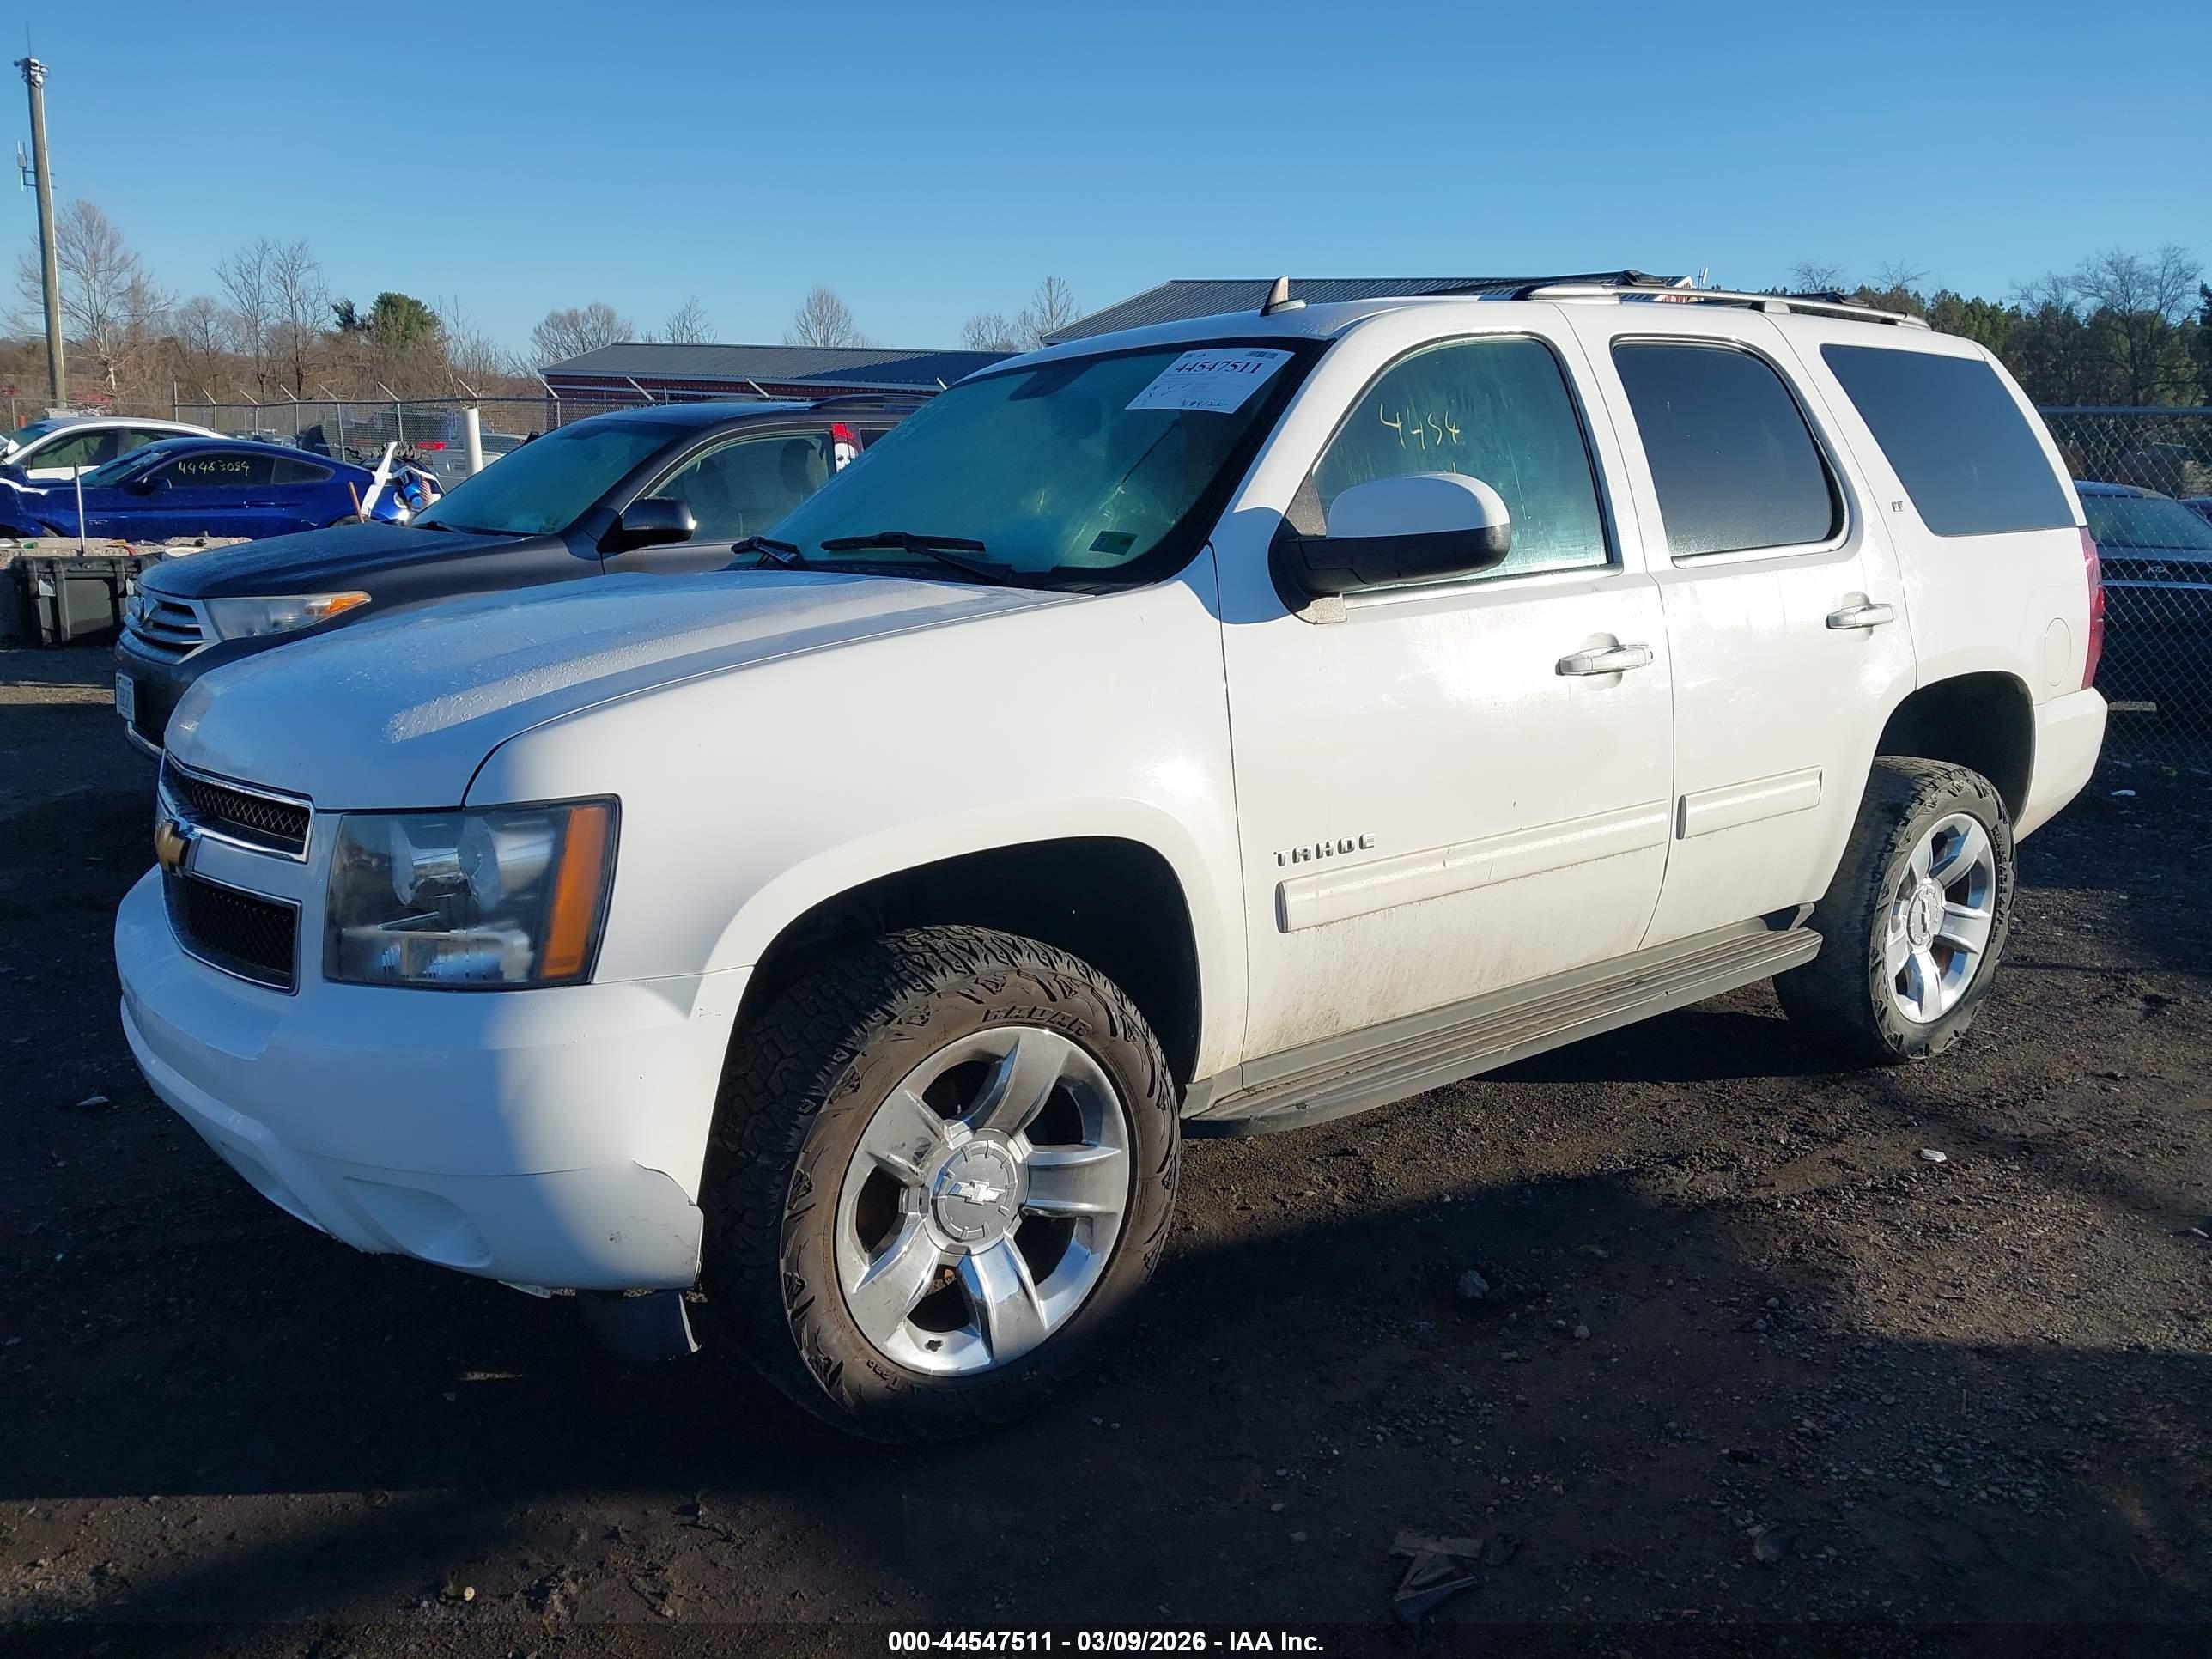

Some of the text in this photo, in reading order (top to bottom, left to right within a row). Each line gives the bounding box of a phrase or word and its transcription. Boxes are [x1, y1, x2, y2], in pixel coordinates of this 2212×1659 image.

[1175, 361, 1264, 374] 44547511
[1380, 402, 1461, 450] 4454
[1273, 833, 1376, 866] TAHOE
[982, 1005, 1093, 1037] RADAR
